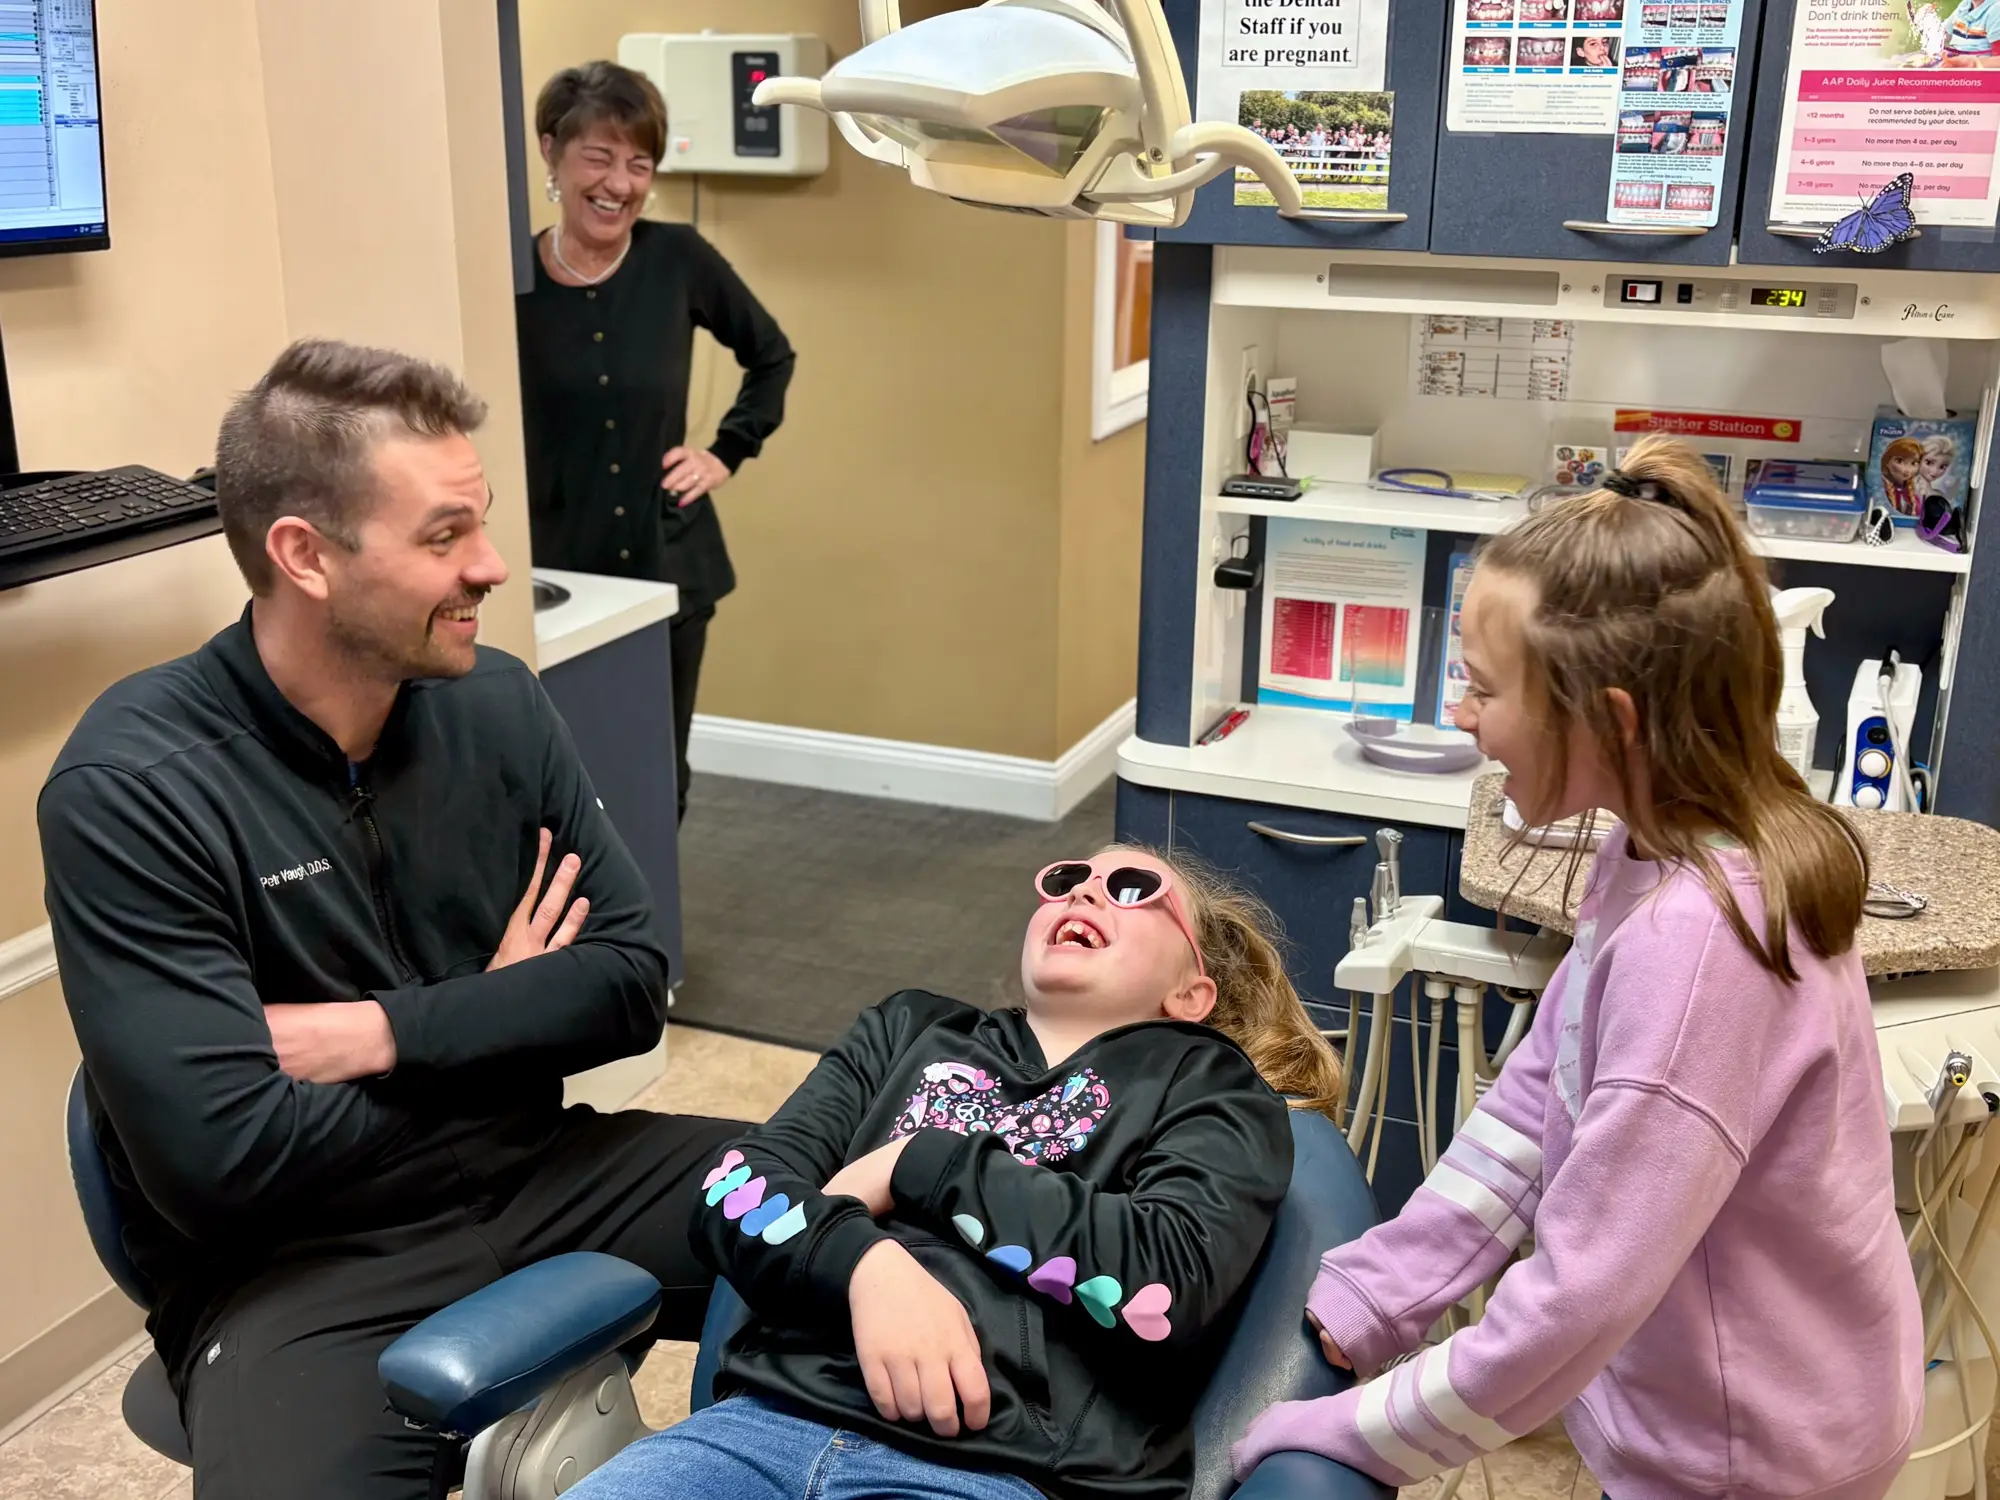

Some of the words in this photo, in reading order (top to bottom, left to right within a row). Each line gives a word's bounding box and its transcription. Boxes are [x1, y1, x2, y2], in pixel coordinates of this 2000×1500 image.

[1831, 0, 1856, 8] your
[1808, 10, 1838, 21] Don't
[1840, 10, 1868, 21] drink
[1871, 11, 1902, 21] them.
[1240, 17, 1287, 35] Staff
[1290, 17, 1306, 35] if
[1308, 22, 1342, 40] you
[1228, 48, 1258, 62] are
[1264, 46, 1352, 67] pregnant.
[1822, 78, 1845, 86] AAP
[1846, 77, 1870, 88] Daily
[1872, 78, 1896, 86] Juice
[1898, 78, 1982, 87] Recommendations
[1766, 290, 1803, 306] 2:34
[1648, 416, 1705, 430] Sticker
[1708, 420, 1766, 434] Station
